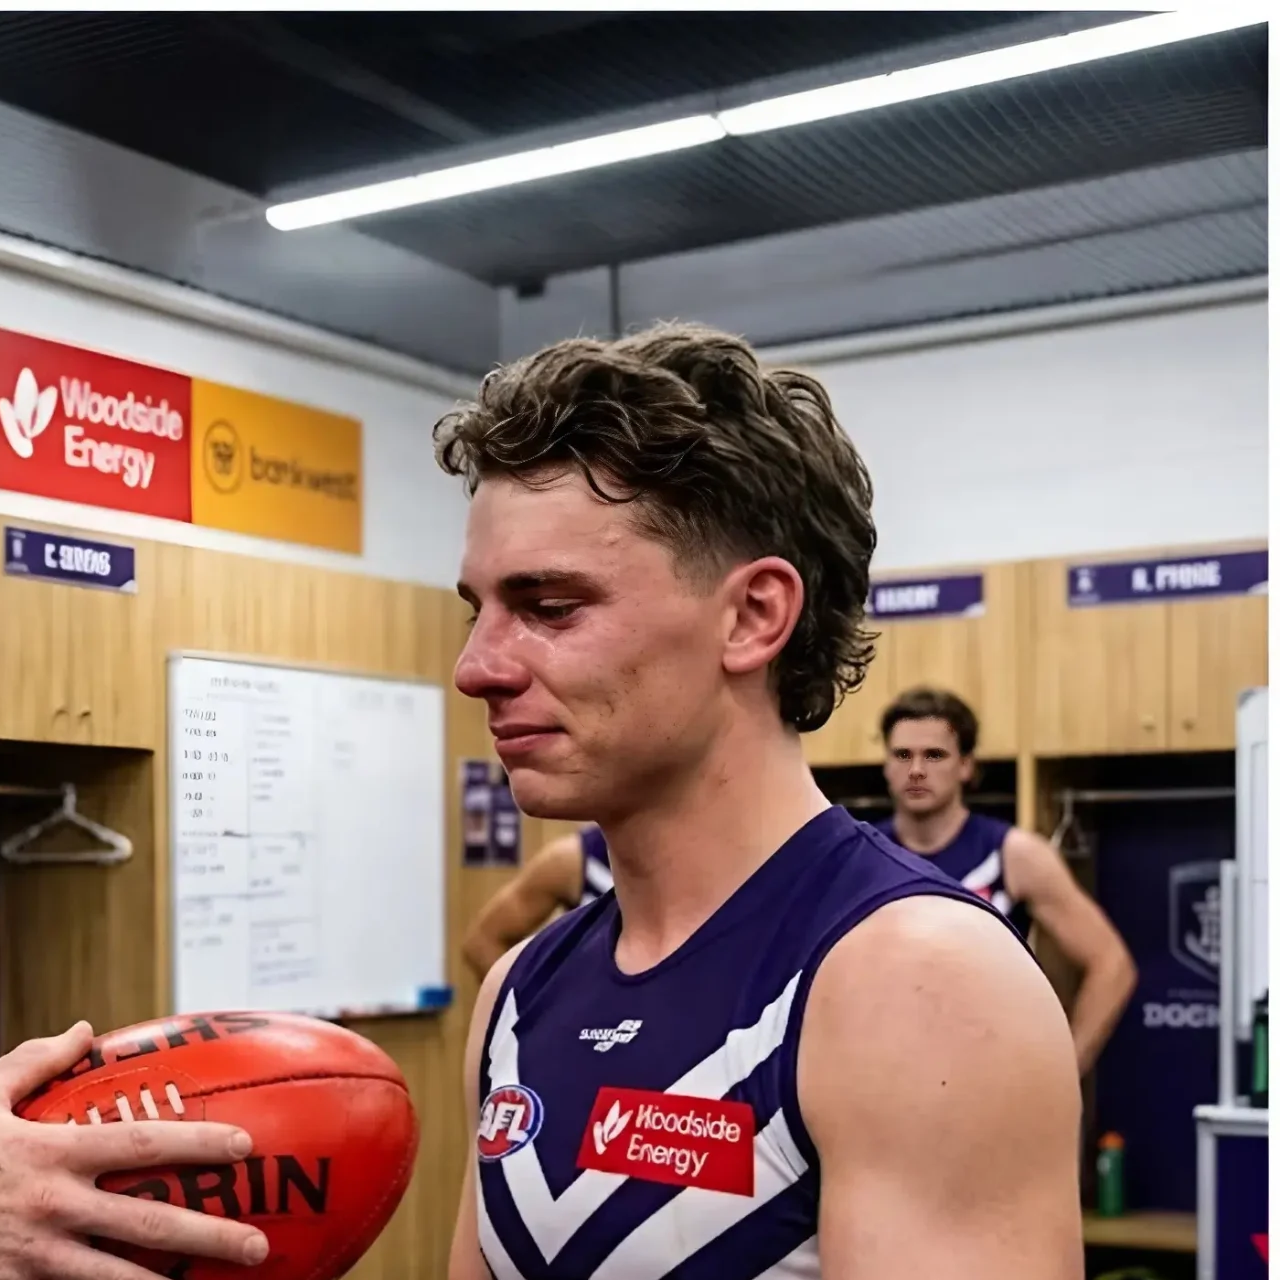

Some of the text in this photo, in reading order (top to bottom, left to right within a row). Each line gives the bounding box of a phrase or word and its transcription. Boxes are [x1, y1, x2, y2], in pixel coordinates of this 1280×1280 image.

[60, 375, 184, 442] Woodside
[63, 426, 156, 489] Energy
[626, 1135, 709, 1177] Energy
